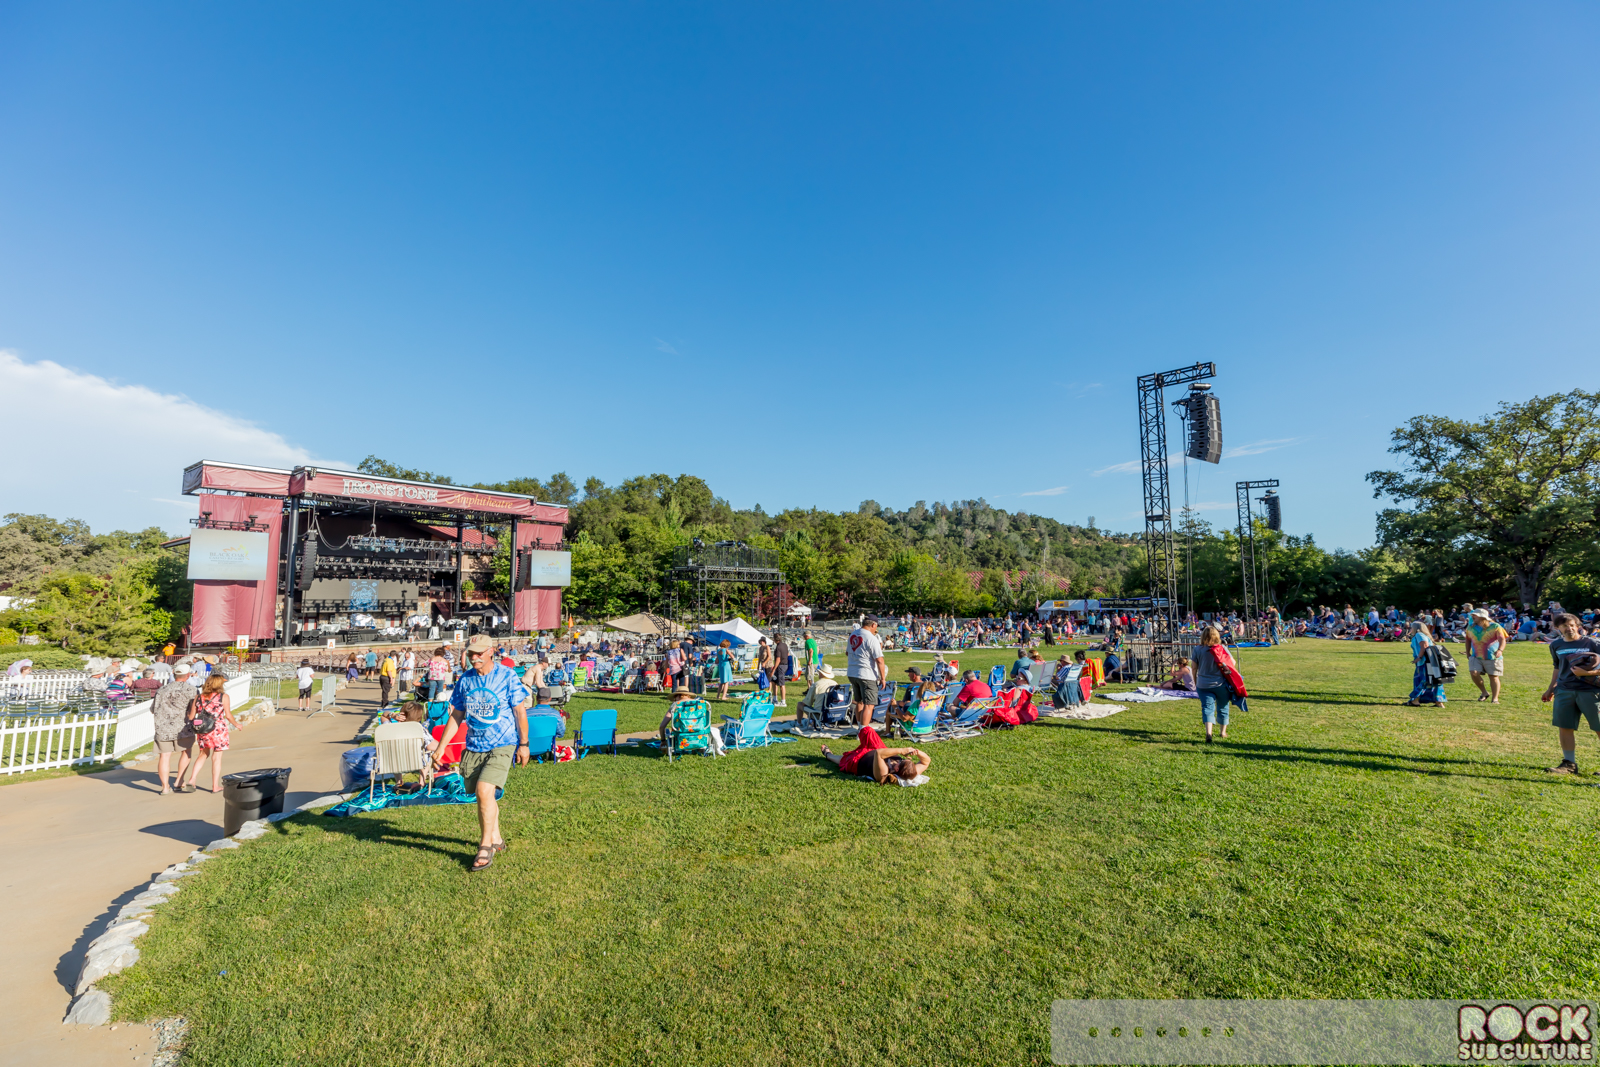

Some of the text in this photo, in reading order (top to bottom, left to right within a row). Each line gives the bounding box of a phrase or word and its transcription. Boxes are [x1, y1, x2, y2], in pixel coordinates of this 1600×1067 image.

[341, 478, 513, 509] IRONSTONE Amphitheatre
[456, 633, 461, 642] E
[239, 638, 246, 648] D
[467, 702, 496, 710] MOODY
